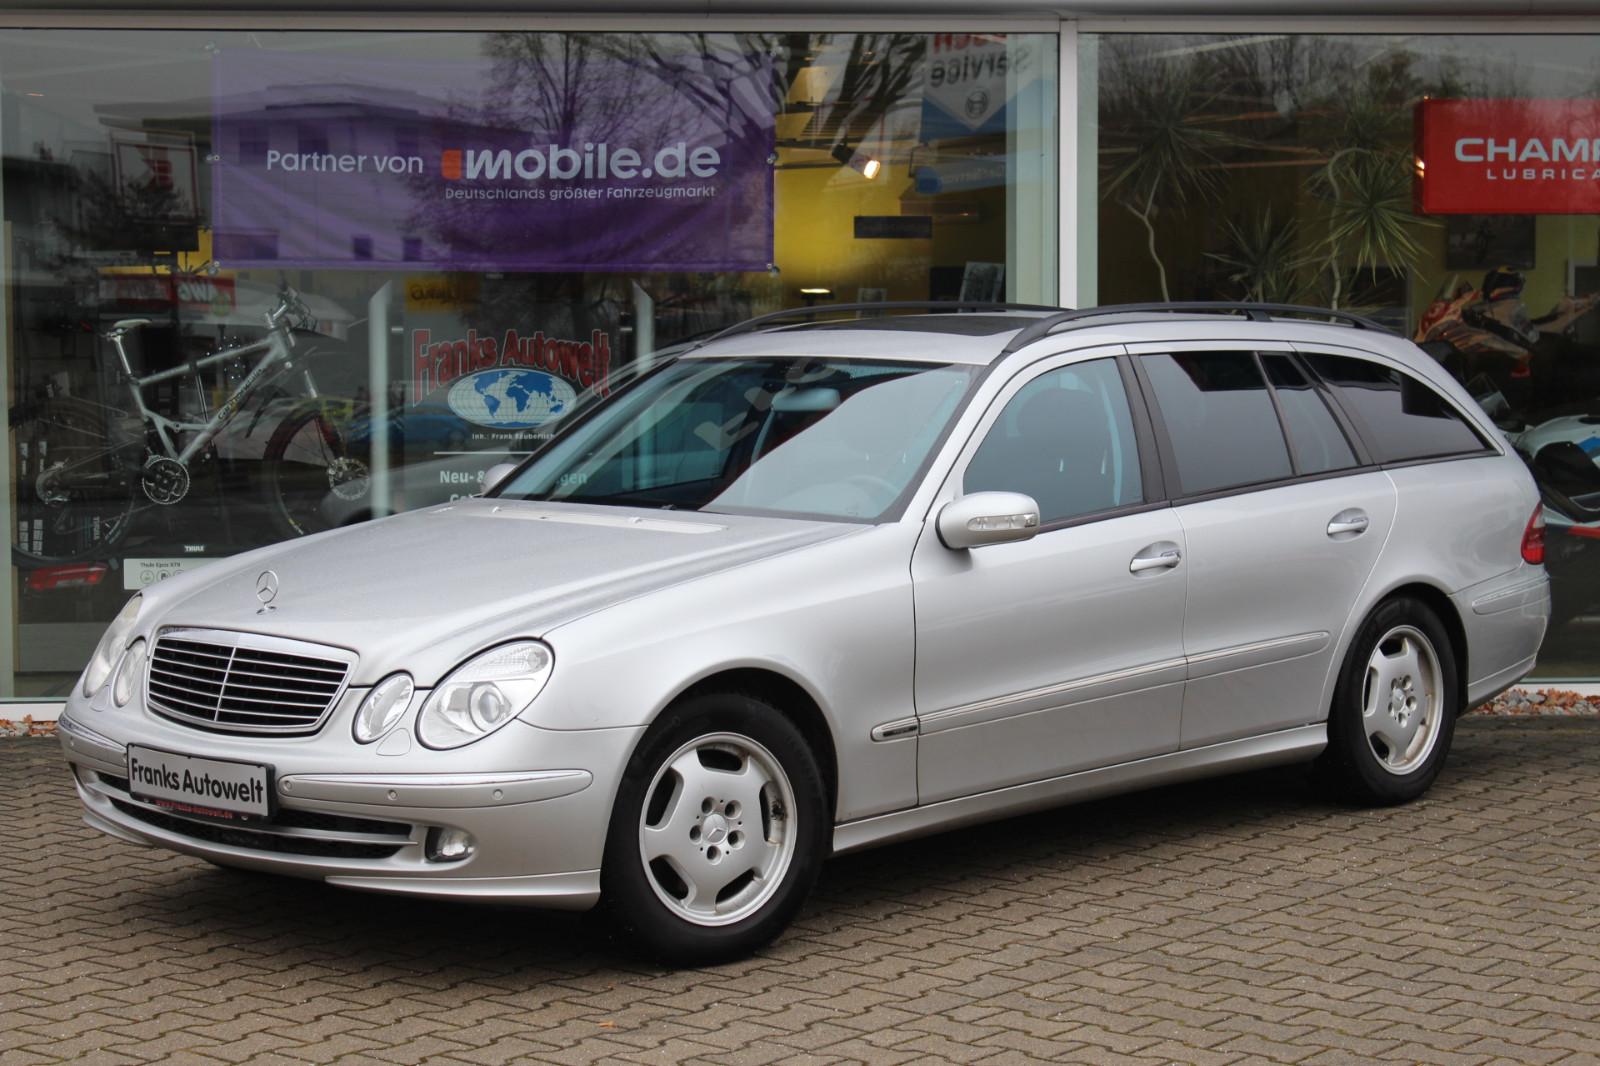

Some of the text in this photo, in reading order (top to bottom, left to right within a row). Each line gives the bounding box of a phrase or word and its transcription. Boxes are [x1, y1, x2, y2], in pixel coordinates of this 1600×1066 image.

[266, 149, 424, 173] Partner von
[465, 142, 721, 180] mobile.de
[1455, 138, 1600, 162] CHAM
[445, 186, 717, 201] Deutschlands größter Fahrzeugmarkt
[413, 328, 611, 408] Franks Autowelt
[440, 470, 474, 484] Neu-
[131, 758, 263, 803] Franks Autowelt
